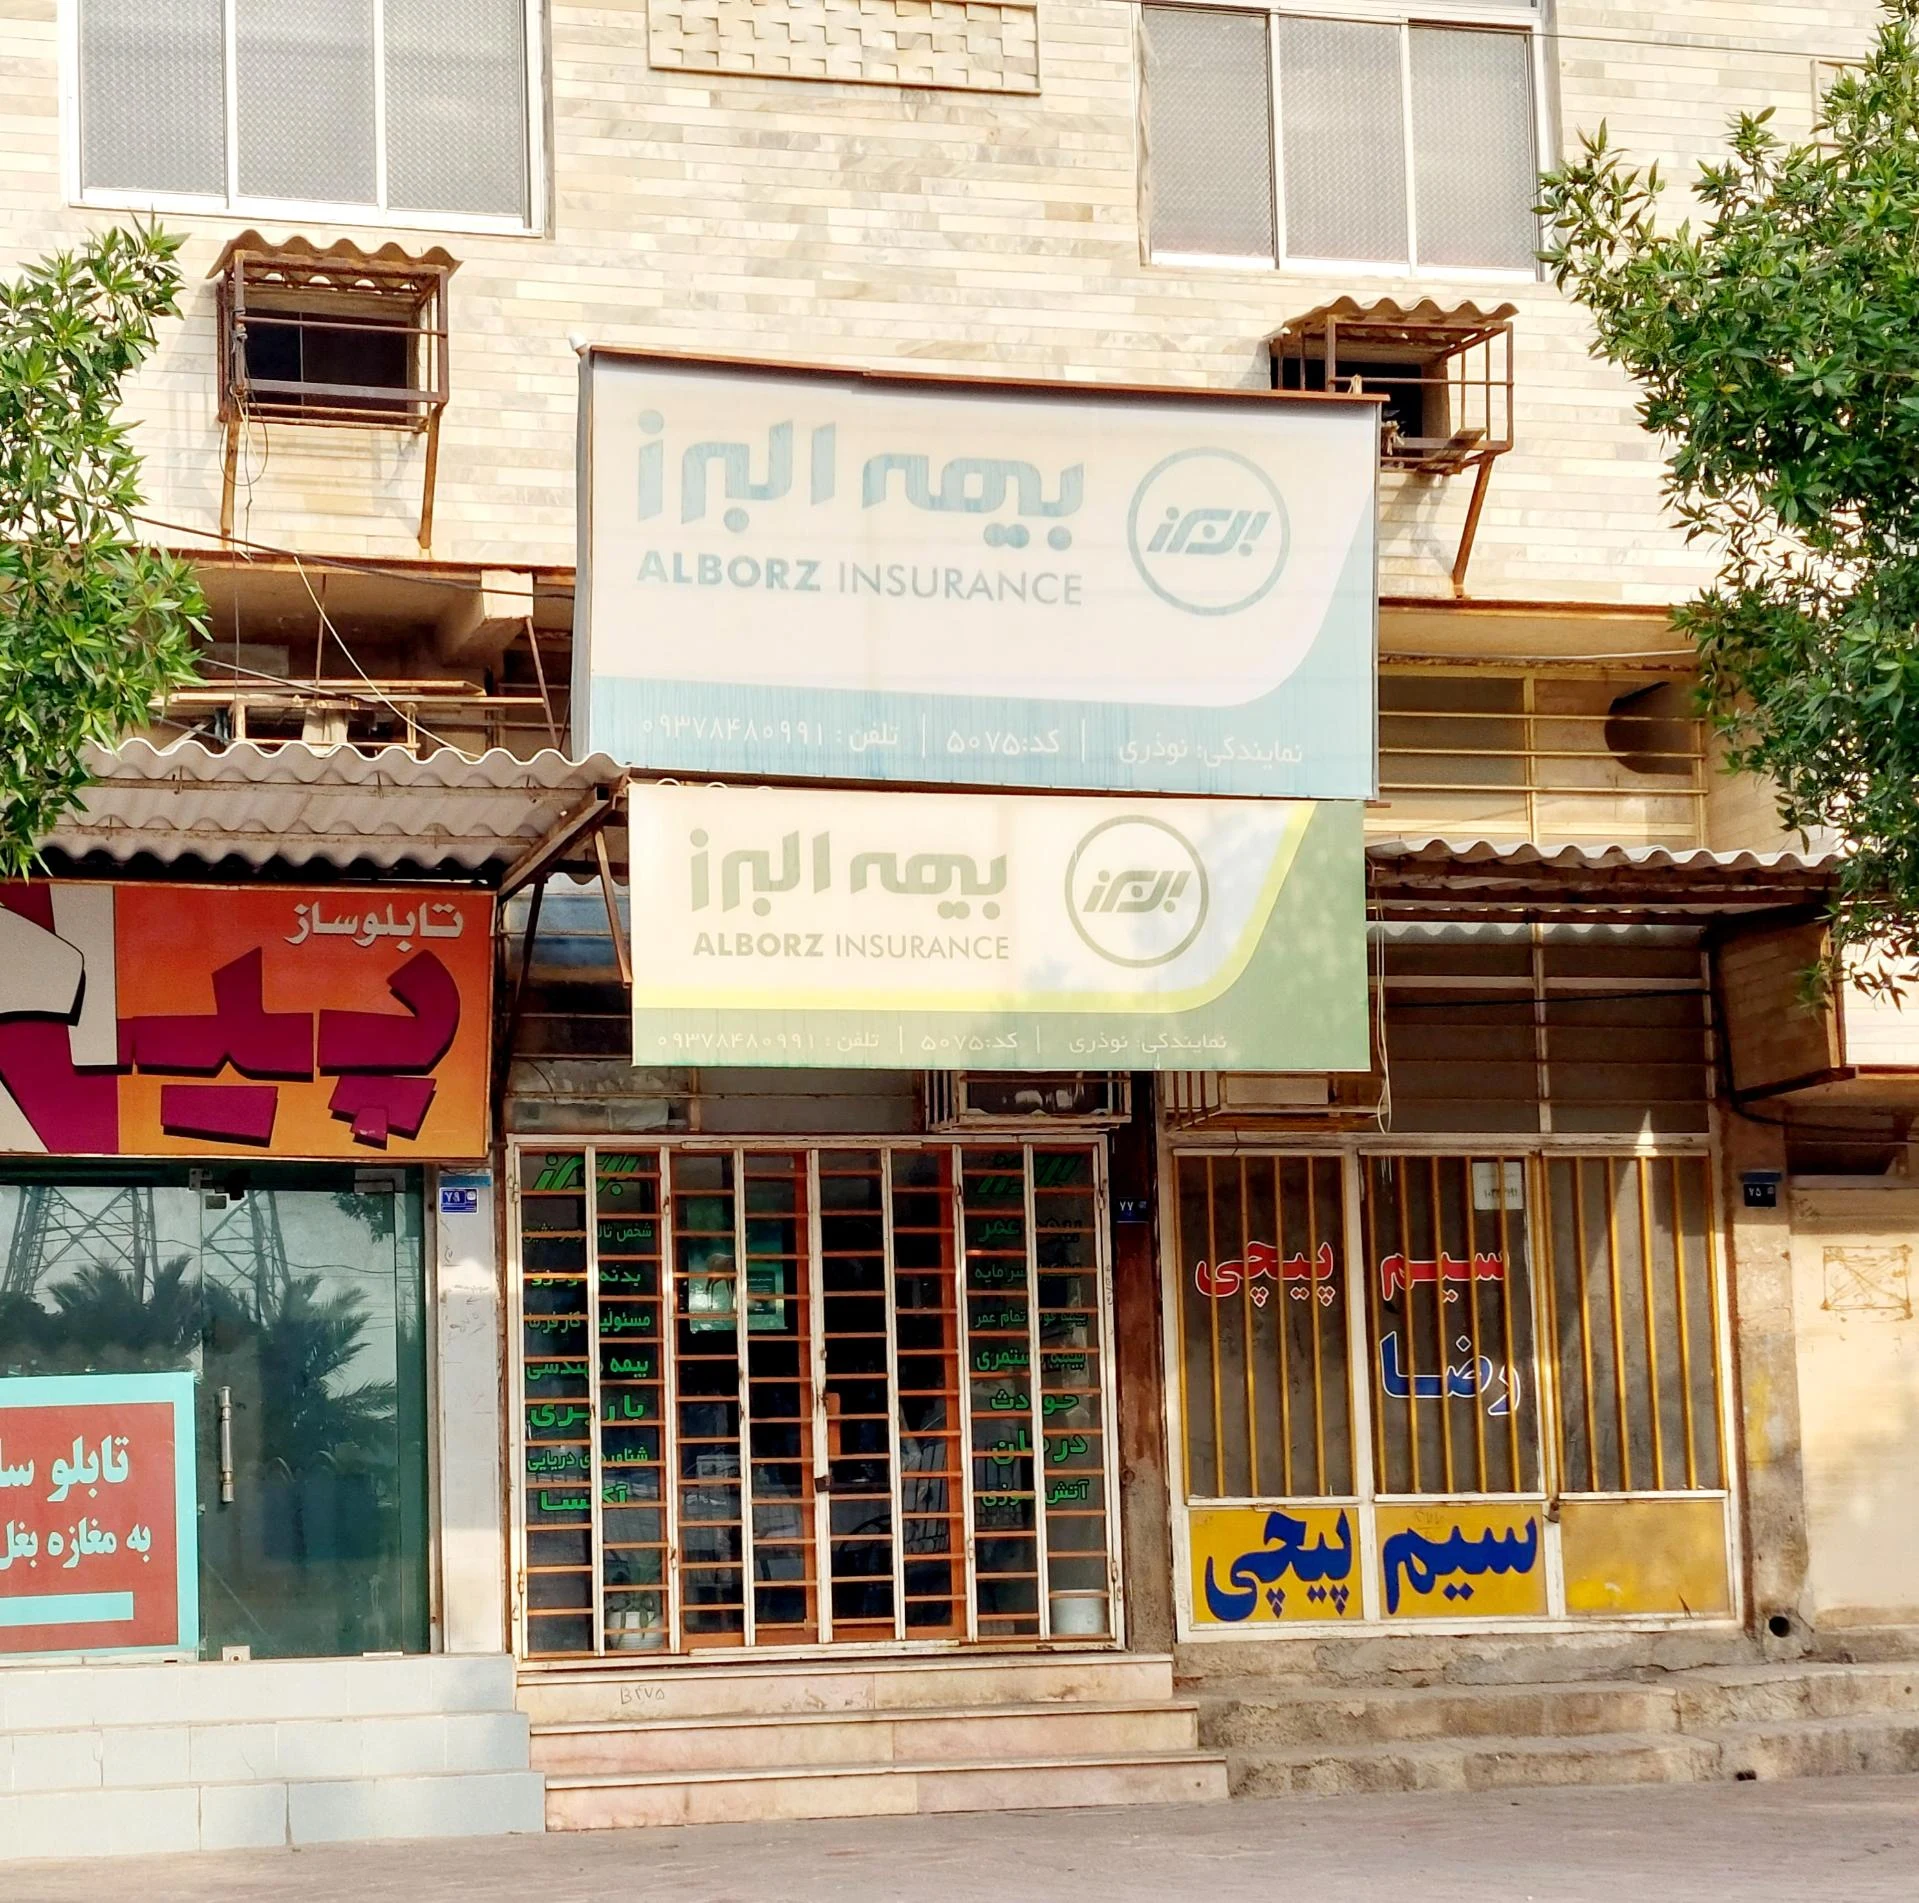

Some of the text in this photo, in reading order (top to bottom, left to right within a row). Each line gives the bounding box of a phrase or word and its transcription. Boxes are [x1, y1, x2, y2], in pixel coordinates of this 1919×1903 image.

[637, 409, 1084, 552] بیمه البرز
[636, 550, 1083, 606] ALBORZ INSURANCE
[642, 712, 824, 746] ۰۹۳۷۸۴۸۰۹۹۱
[1118, 731, 1189, 765] نوذری
[690, 828, 1008, 921] بیمه البرز
[284, 900, 464, 953] تابلوساز
[692, 932, 1010, 961] ALBORZ INSURANCE
[657, 1032, 815, 1049] ۰۹۳۷۸۴۸۰۹۹۱
[1068, 1031, 1129, 1053] نوذری
[616, 1221, 653, 1242] شخص
[977, 1219, 1019, 1243] عمر
[599, 1264, 642, 1287] بدنه
[1194, 1239, 1510, 1308] سیم پیچی
[598, 1306, 651, 1333] مسئولی
[975, 1313, 997, 1329] عمر
[1000, 1308, 1026, 1327] تمام
[609, 1357, 649, 1378] بیمه
[1379, 1330, 1521, 1416] رضا
[46, 1434, 130, 1502] تابلو
[527, 1450, 576, 1471] دریایی
[1042, 1479, 1091, 1505] آتش
[0, 1516, 152, 1571] به مغازه بغل
[1204, 1507, 1538, 1622] سیم پیچی
